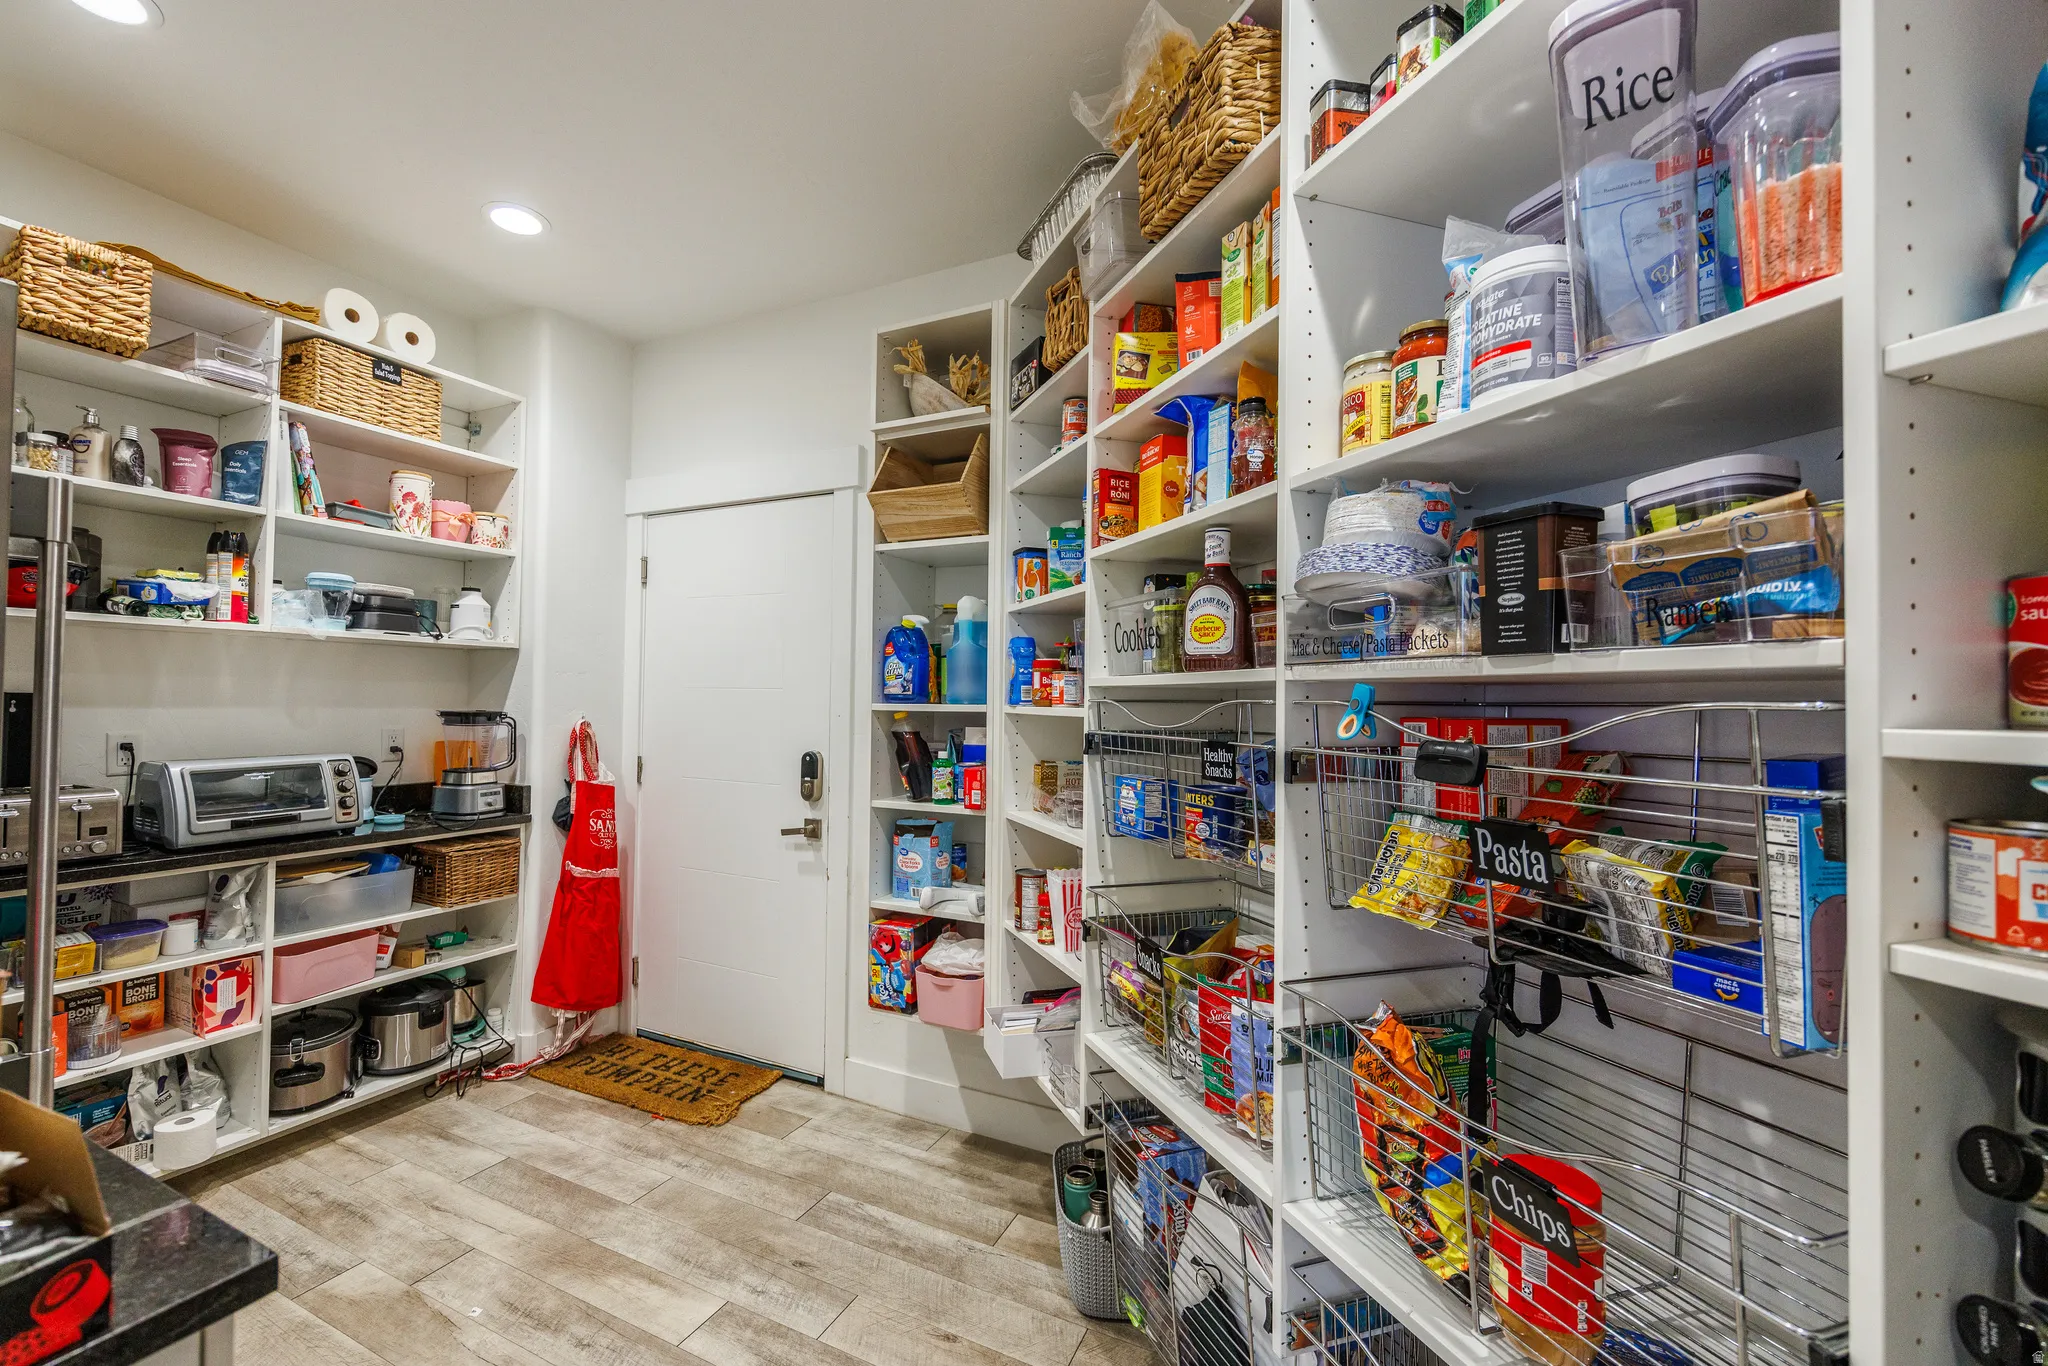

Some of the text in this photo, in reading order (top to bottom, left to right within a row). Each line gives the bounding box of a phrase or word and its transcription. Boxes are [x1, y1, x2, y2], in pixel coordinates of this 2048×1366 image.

[1582, 65, 1675, 131] Rice
[172, 461, 197, 469] Essentials
[177, 455, 192, 463] Sleep
[229, 460, 242, 468] Daily
[1110, 478, 1130, 488] RICE
[1110, 490, 1130, 500] RONI
[1202, 596, 1216, 605] BABY
[1645, 597, 1732, 628] Ramen
[1114, 617, 1161, 654] Cookies
[1193, 624, 1222, 633] Barbecue
[1198, 631, 1216, 639] Sauce
[1292, 638, 1310, 657] Mac
[1312, 637, 1321, 656] &
[1399, 629, 1449, 651] Packets
[1203, 747, 1233, 767] Healthy
[1204, 762, 1233, 779] Snacks
[1065, 778, 1082, 786] HOT
[1474, 827, 1549, 885] Pasta
[1775, 851, 1798, 863] 270 370
[1137, 943, 1162, 981] Snacks
[125, 983, 157, 997] BONE
[125, 992, 157, 1005] BROTH
[68, 1004, 100, 1019] BONE
[602, 1043, 740, 1087] HI THERE
[564, 1055, 717, 1104] PUMPKIN
[154, 1092, 173, 1108] Ritual
[1978, 1137, 1999, 1184] PARSLEY
[1491, 1175, 1571, 1248] Chips
[1990, 1319, 2000, 1348] MINT
